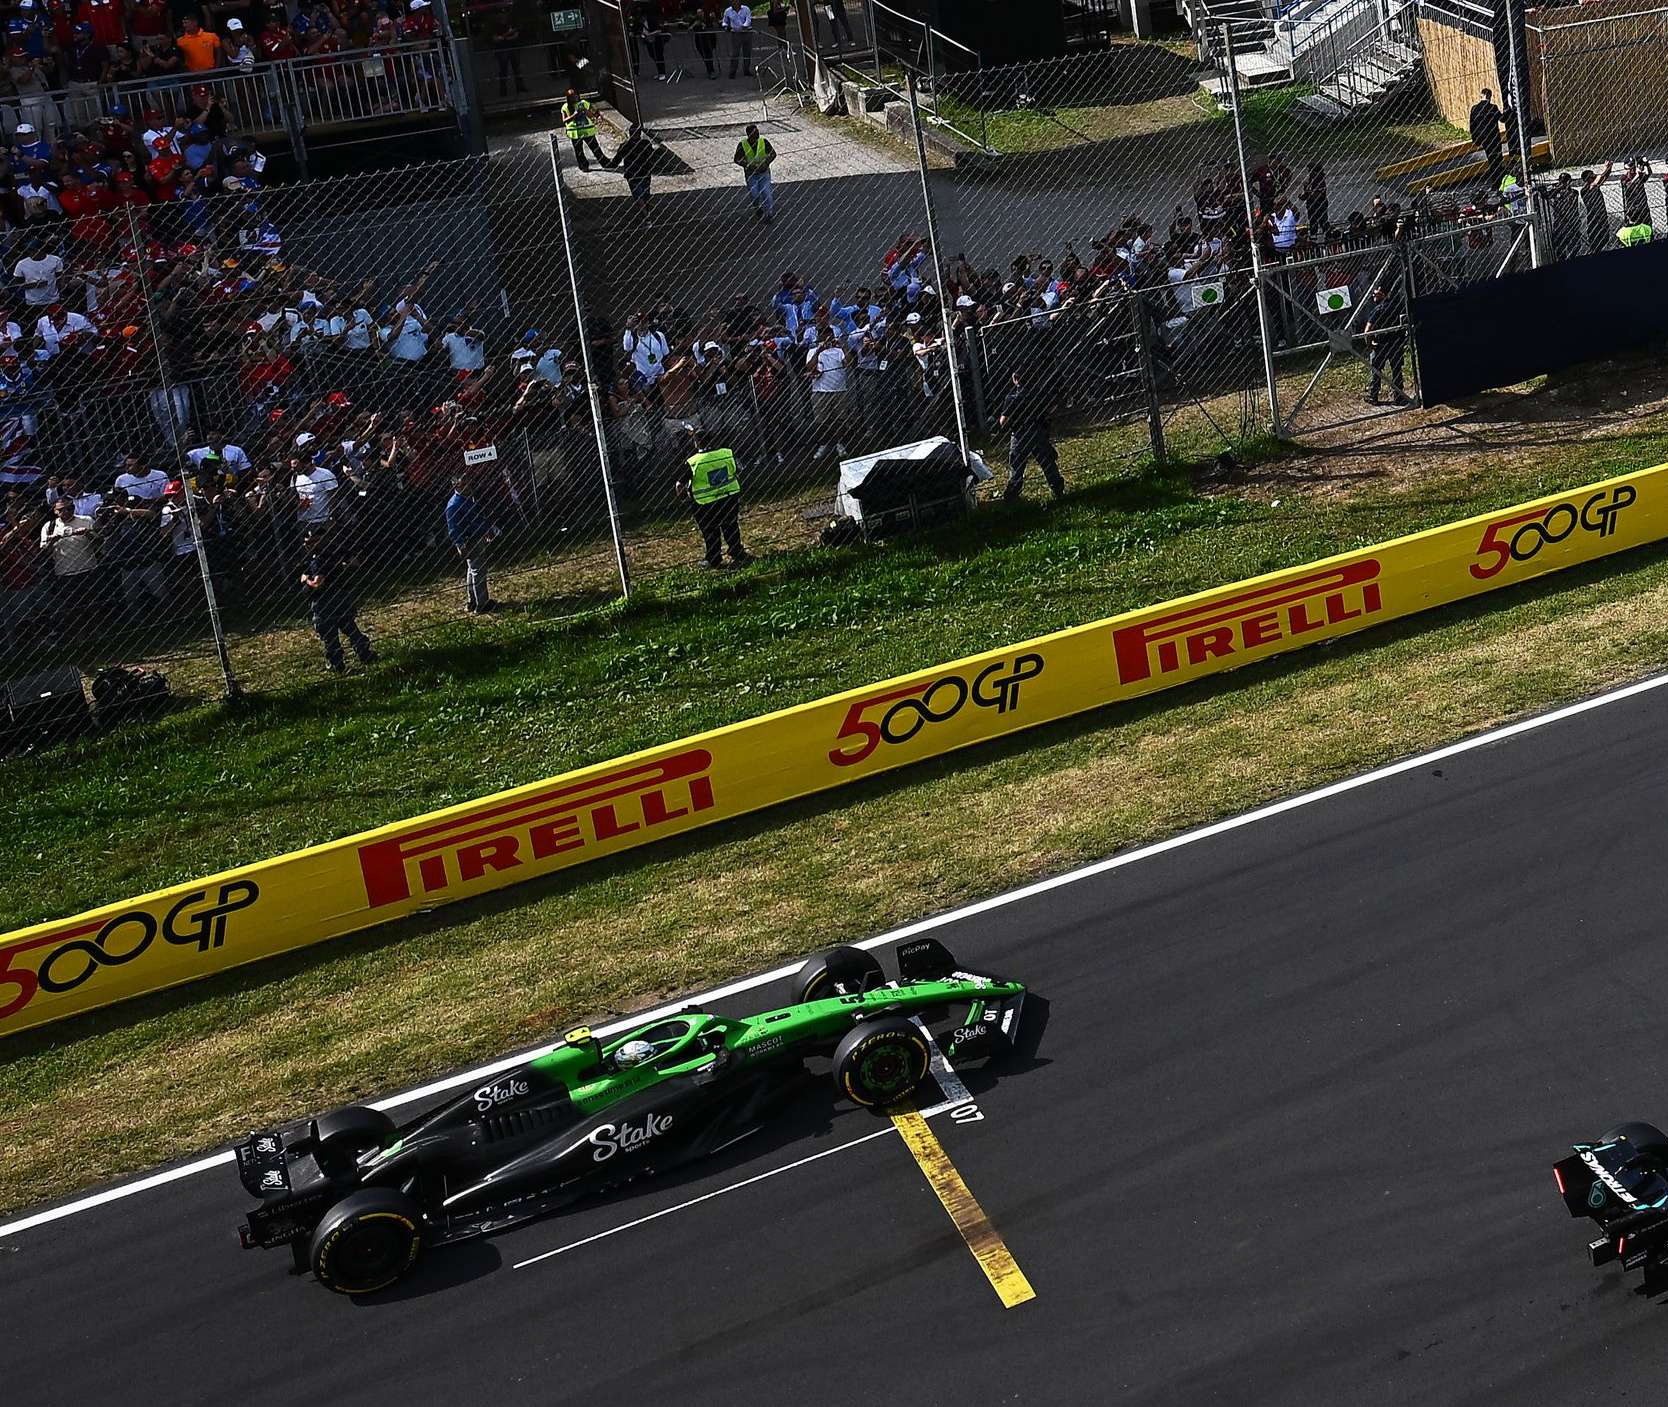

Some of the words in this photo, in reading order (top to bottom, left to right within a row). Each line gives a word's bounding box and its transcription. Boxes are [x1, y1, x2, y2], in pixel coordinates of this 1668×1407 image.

[468, 452, 487, 461] ROW
[1112, 559, 1382, 685] PIRELLI
[358, 748, 715, 908] PIRELLI
[901, 942, 931, 958] PicPay
[953, 1022, 988, 1044] Stake
[748, 1035, 783, 1054] MASCOT
[472, 1079, 530, 1112] Stake
[950, 1104, 986, 1125] 07
[588, 1112, 674, 1162] Stake
[624, 1138, 651, 1154] sports
